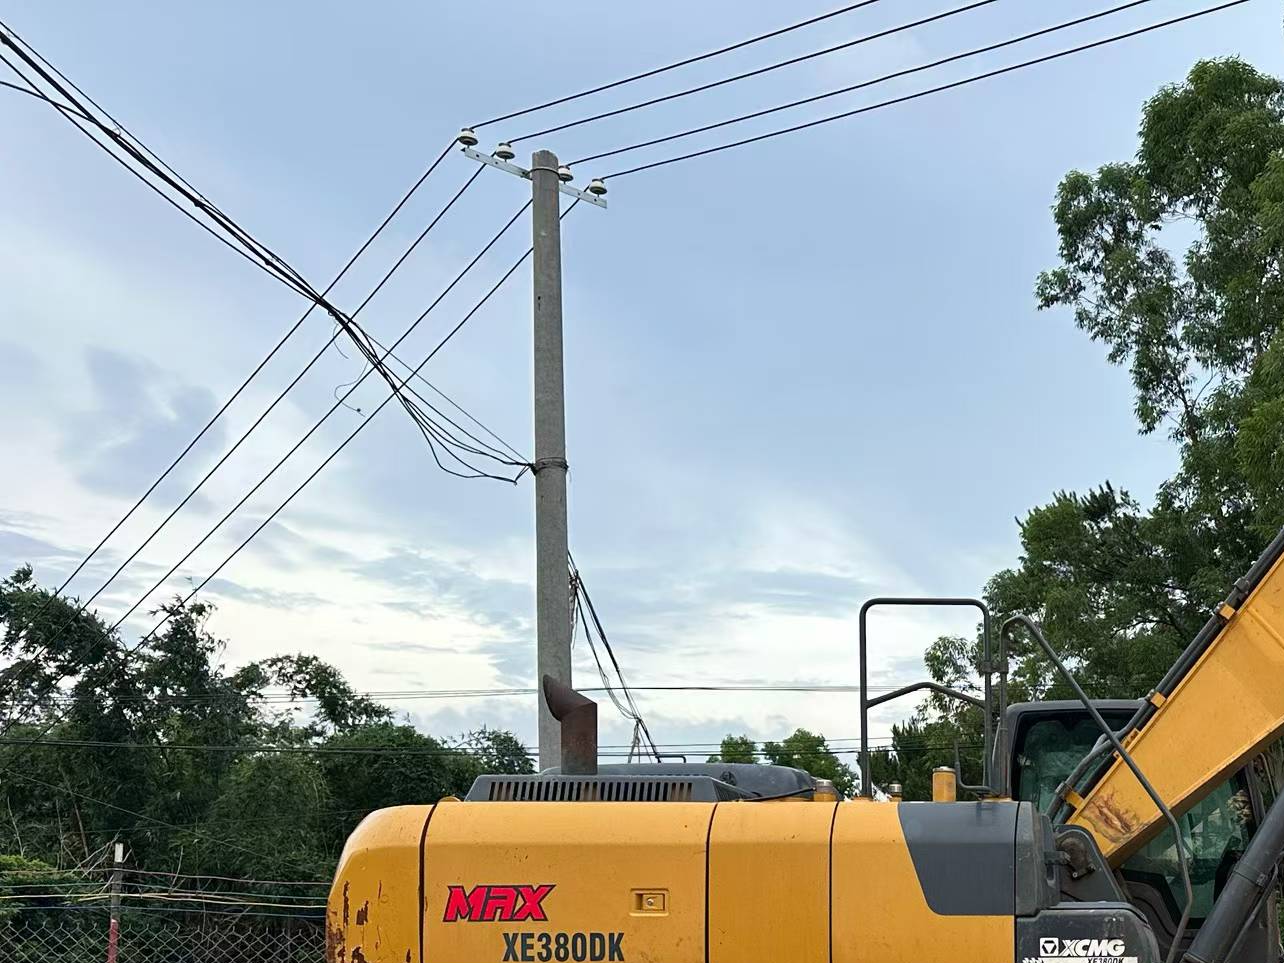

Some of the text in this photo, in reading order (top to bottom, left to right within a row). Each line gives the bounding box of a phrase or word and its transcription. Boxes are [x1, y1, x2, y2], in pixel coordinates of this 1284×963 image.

[443, 884, 556, 922] MAX
[502, 932, 624, 962] XE380DK
[1059, 939, 1125, 956] XCMG
